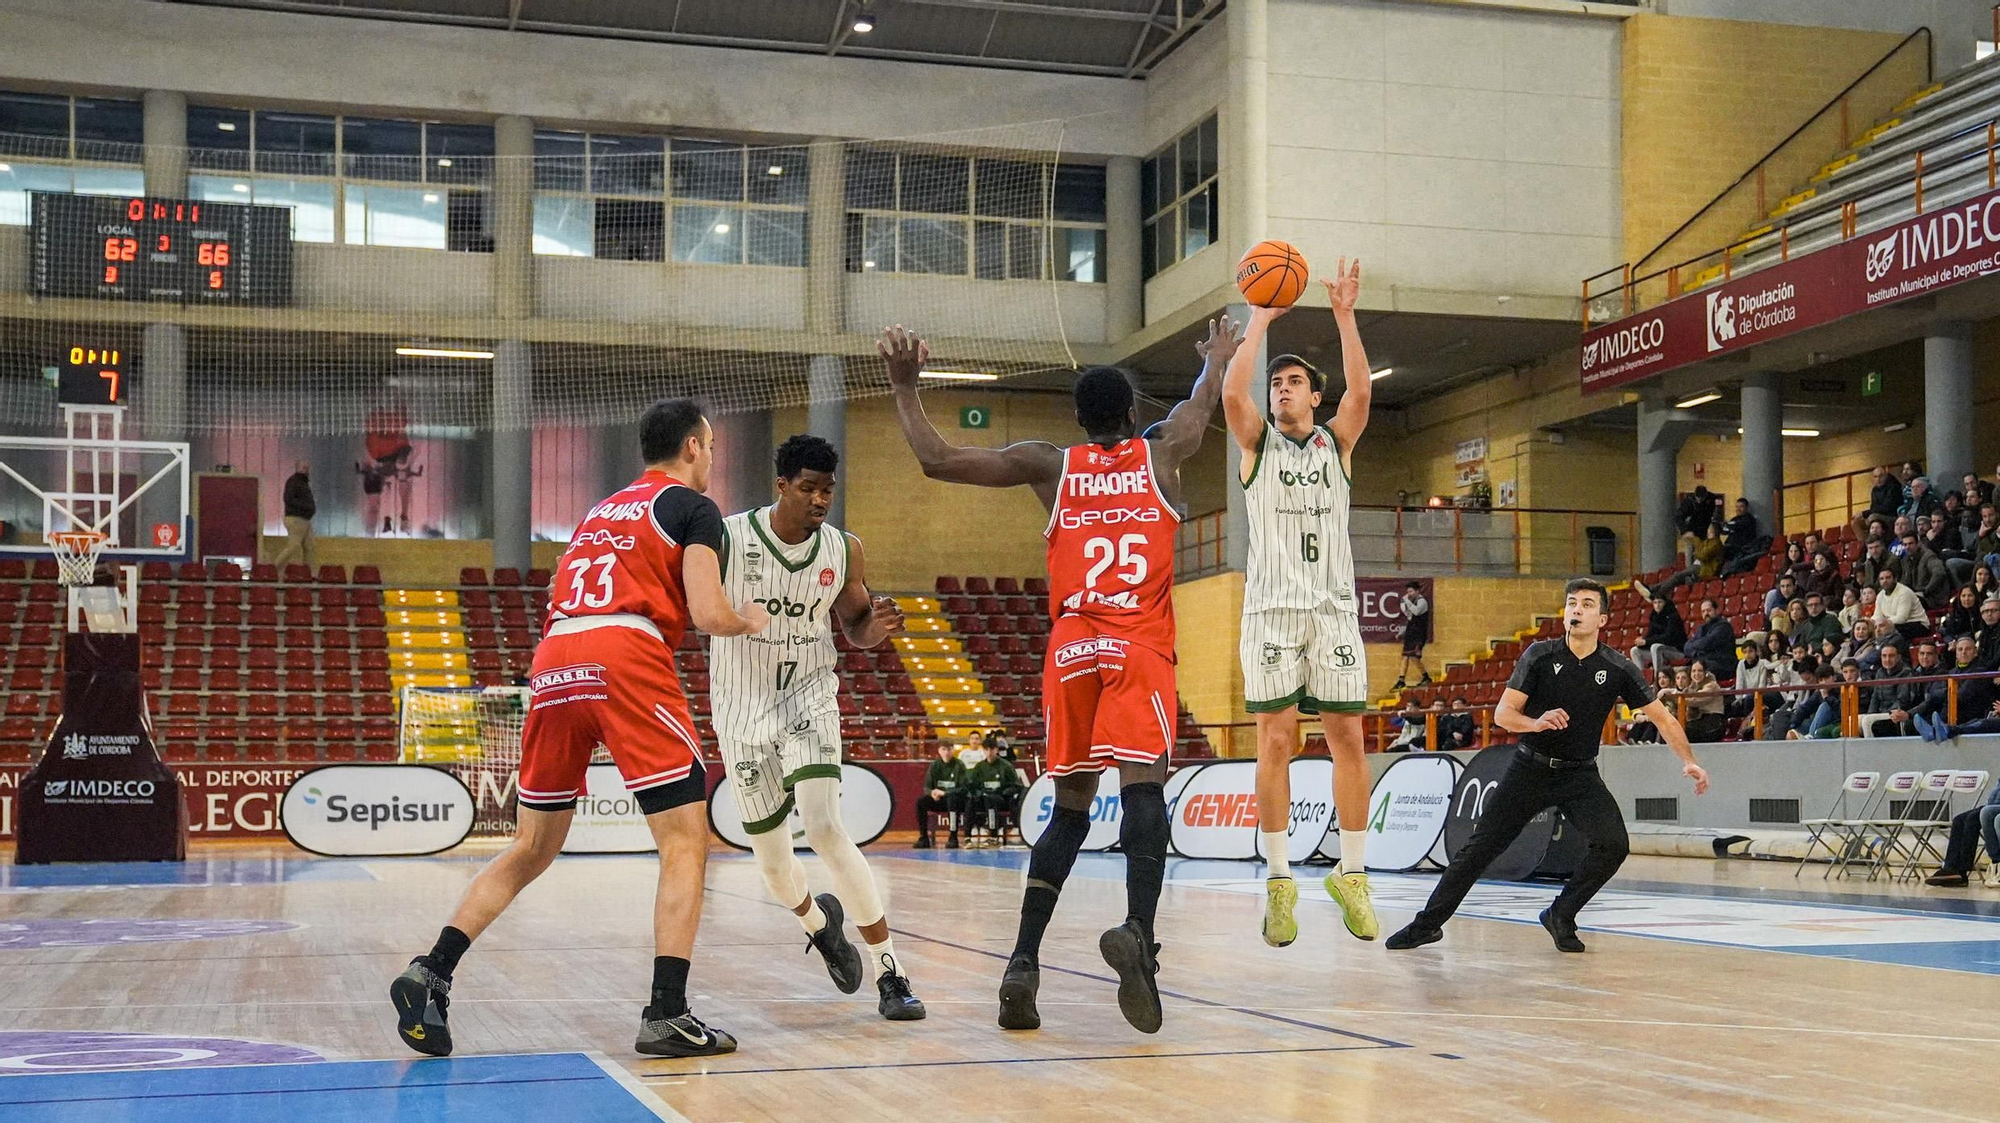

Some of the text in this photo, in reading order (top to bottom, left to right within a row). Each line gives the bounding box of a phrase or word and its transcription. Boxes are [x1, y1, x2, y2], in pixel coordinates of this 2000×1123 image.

[97, 224, 135, 236] LOCAL
[104, 238, 138, 262] 62
[198, 243, 229, 266] 66
[209, 271, 223, 289] 5
[1867, 286, 1898, 304] Instituto
[1900, 270, 1938, 295] Municipal
[1940, 268, 1951, 282] de
[1952, 256, 1992, 279] Deportes
[1738, 282, 1795, 315] Diputación
[1739, 304, 1796, 336] de Córdoba
[1600, 318, 1664, 364] IMDECO
[99, 371, 119, 401] 7
[1066, 465, 1149, 497] TRAORÉ
[1060, 506, 1160, 530] Geoxa
[1083, 533, 1149, 589] 25
[1301, 532, 1319, 563] 16
[559, 552, 617, 611] 33
[747, 634, 786, 646] Fundación
[776, 661, 798, 691] 17
[89, 735, 140, 746] AYUNTAMIENTO
[70, 780, 155, 797] IMDECO
[326, 795, 455, 831] Sepisur
